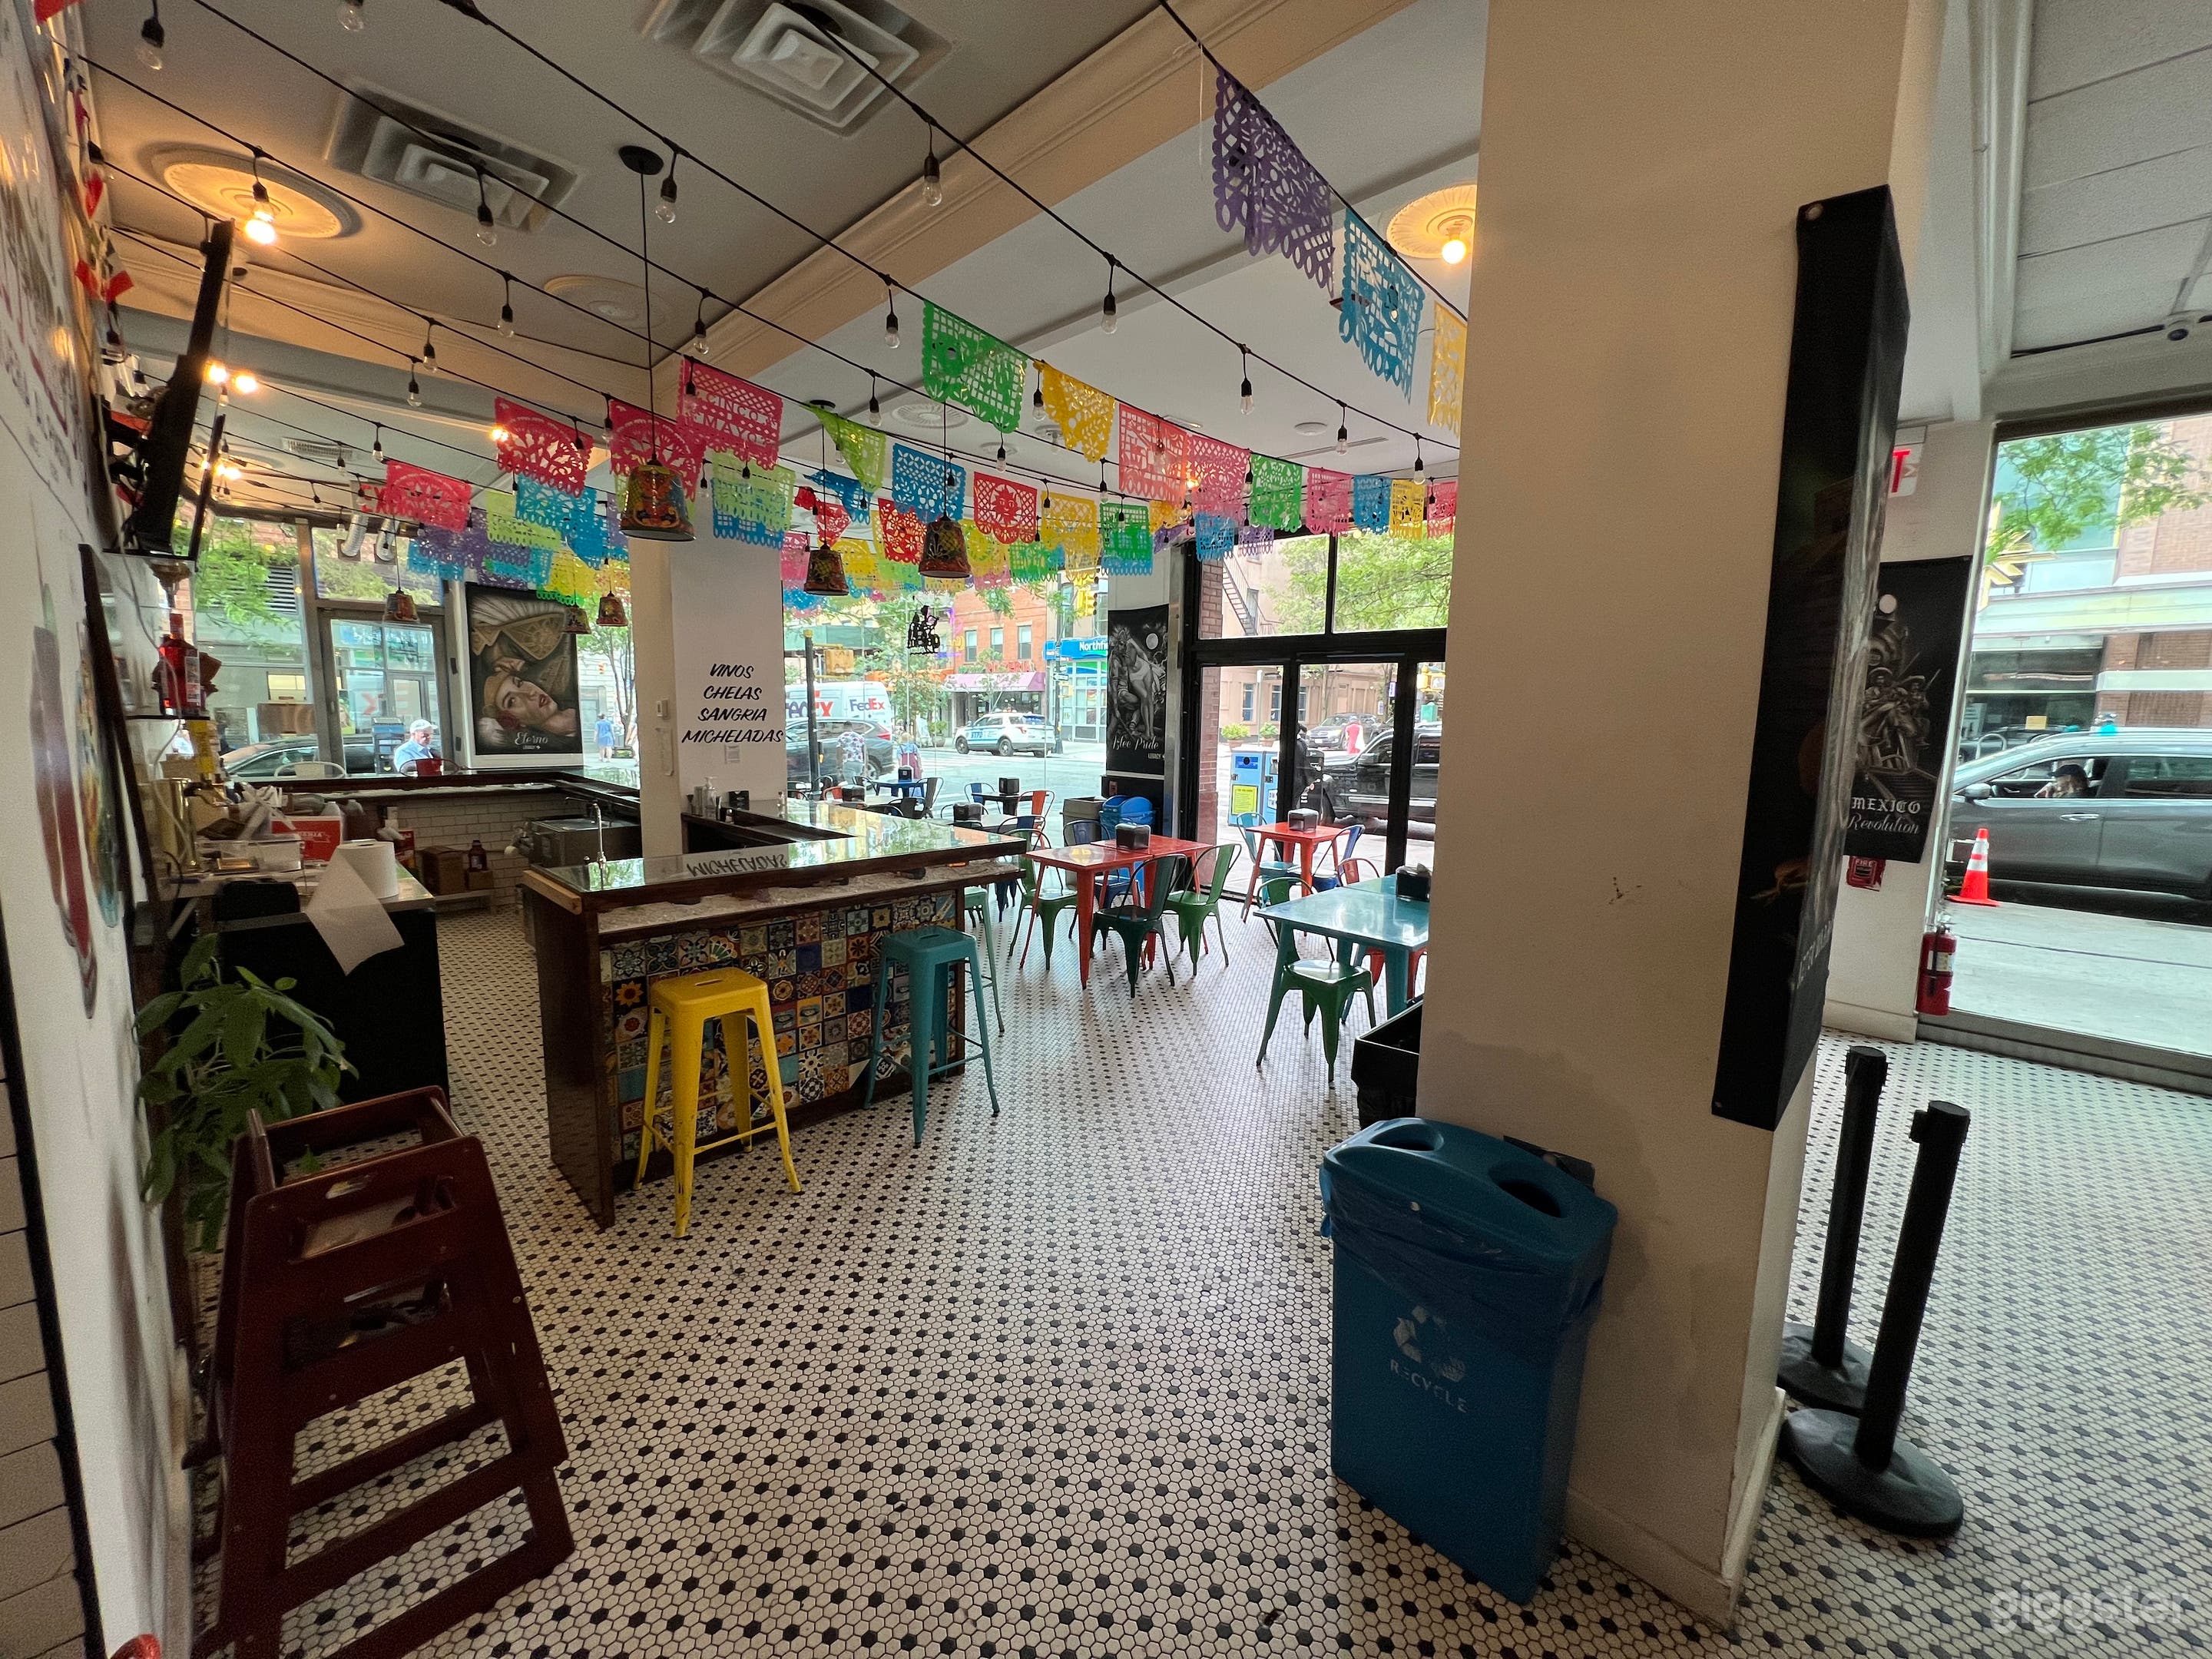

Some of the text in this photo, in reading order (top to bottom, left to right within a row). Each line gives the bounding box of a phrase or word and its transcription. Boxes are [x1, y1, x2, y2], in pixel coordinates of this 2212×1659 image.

[710, 664, 754, 679] VINOS
[703, 685, 762, 700] CHELAS
[849, 698, 886, 712] FedEx
[697, 707, 767, 721] SANGRIA
[681, 729, 784, 743] MICHELADAS
[1135, 735, 1159, 750] Pride
[1851, 796, 1921, 814] MEXICO
[1847, 813, 1919, 834] Revolution
[1855, 859, 1874, 867] FIRE
